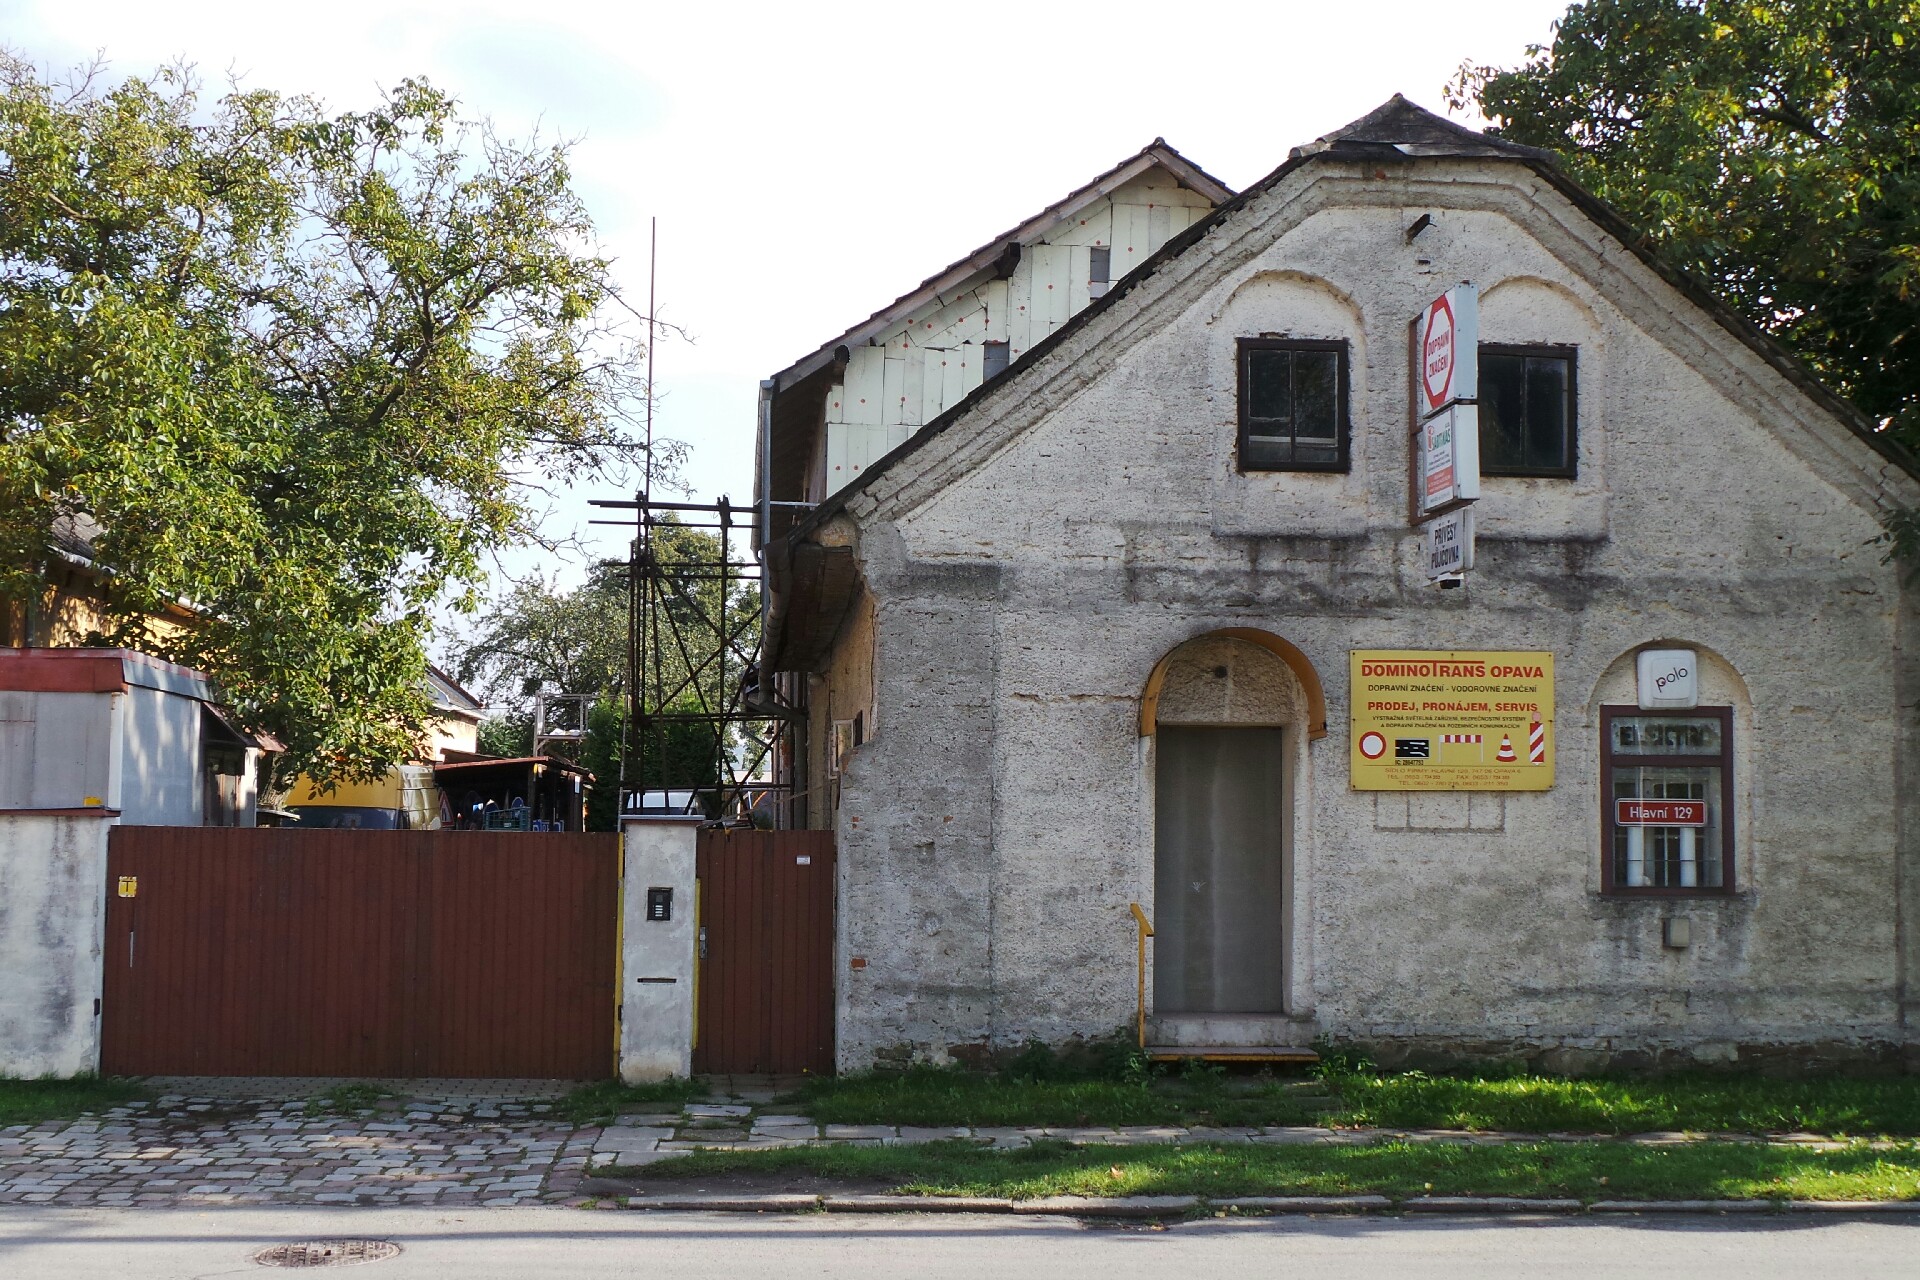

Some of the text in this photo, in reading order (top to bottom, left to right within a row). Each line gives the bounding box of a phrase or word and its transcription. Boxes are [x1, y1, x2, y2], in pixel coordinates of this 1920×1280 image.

[1428, 351, 1448, 378] ZNAČENÍ
[1361, 659, 1543, 678] DOMINOTRANS OPAVA
[1655, 667, 1688, 693] polo
[1368, 683, 1408, 692] DOPRAVNÍ
[1410, 683, 1444, 692] ZNAČENÍ
[1503, 684, 1537, 693] ZNAČENÍ
[1368, 701, 1538, 713] PRODEJ, PRONÁJEM, SERVIS
[1629, 807, 1693, 819] Hlavní 129
